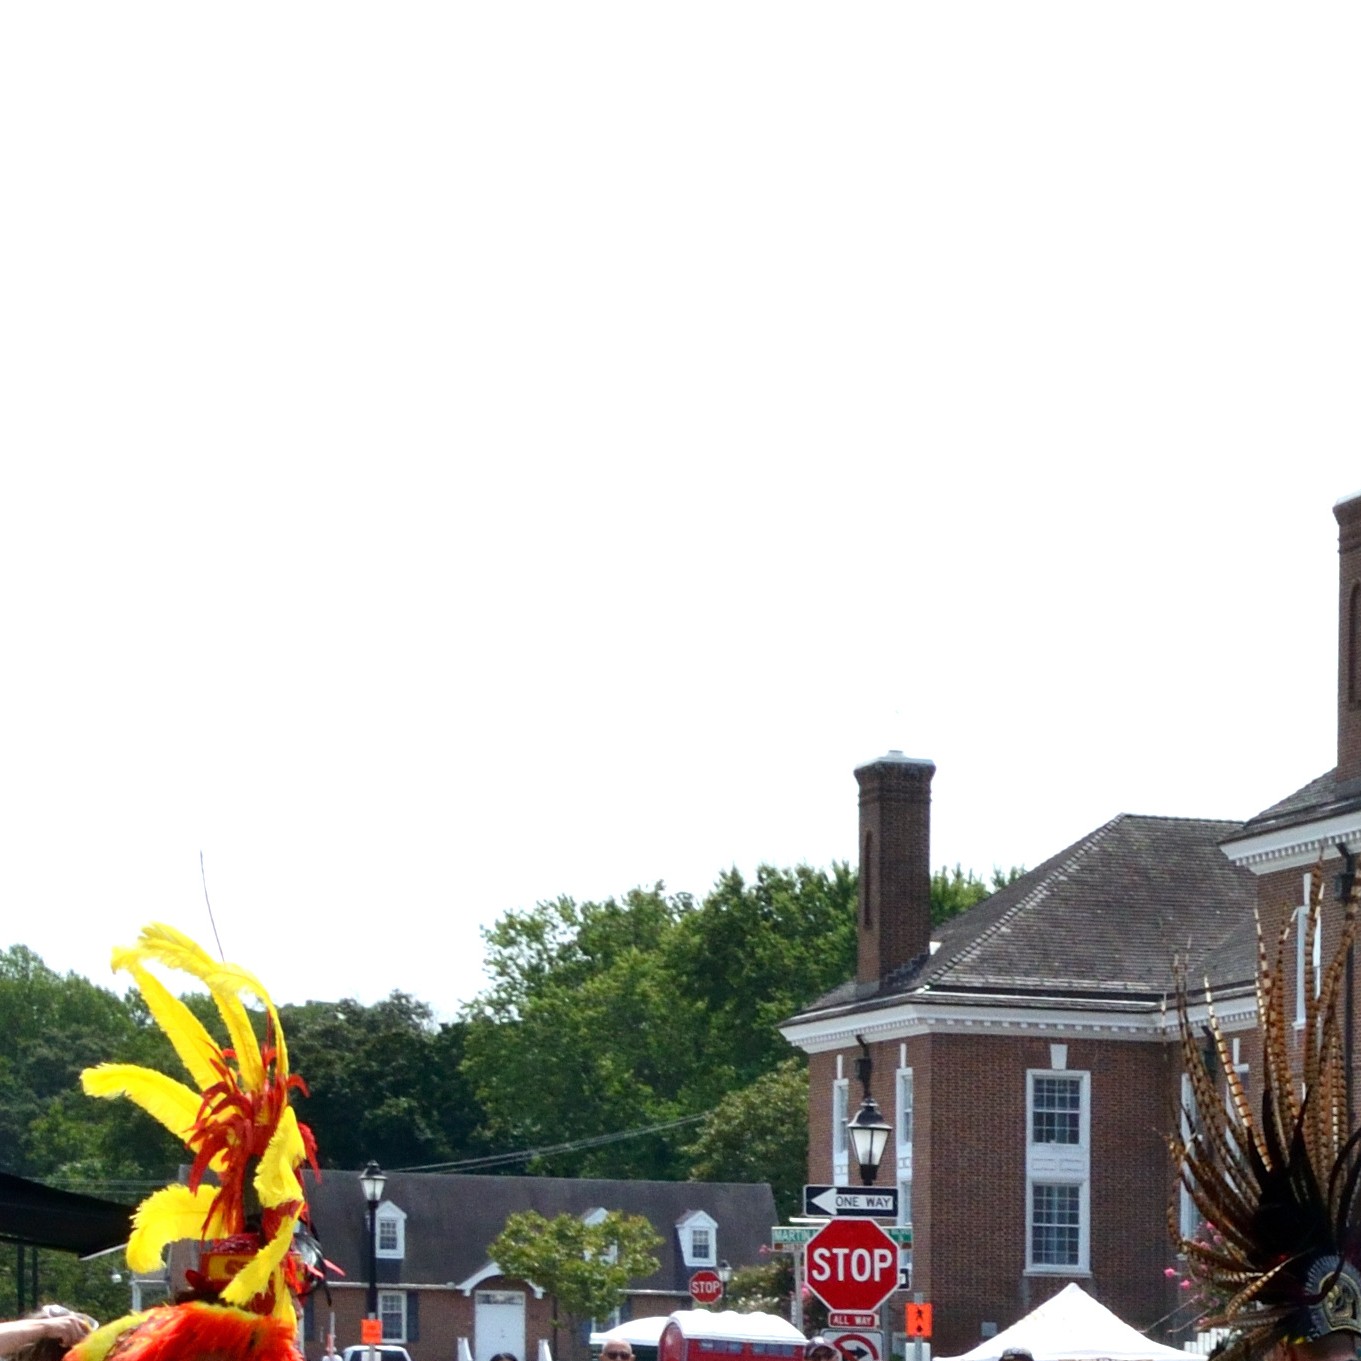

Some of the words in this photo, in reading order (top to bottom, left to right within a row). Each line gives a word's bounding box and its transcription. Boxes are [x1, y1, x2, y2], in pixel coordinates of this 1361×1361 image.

[835, 1195, 860, 1208] ONE
[866, 1196, 892, 1208] WAY
[811, 1248, 893, 1282] STOP
[692, 1281, 720, 1294] STOP
[832, 1316, 849, 1325] ALL
[854, 1317, 872, 1326] WAY
